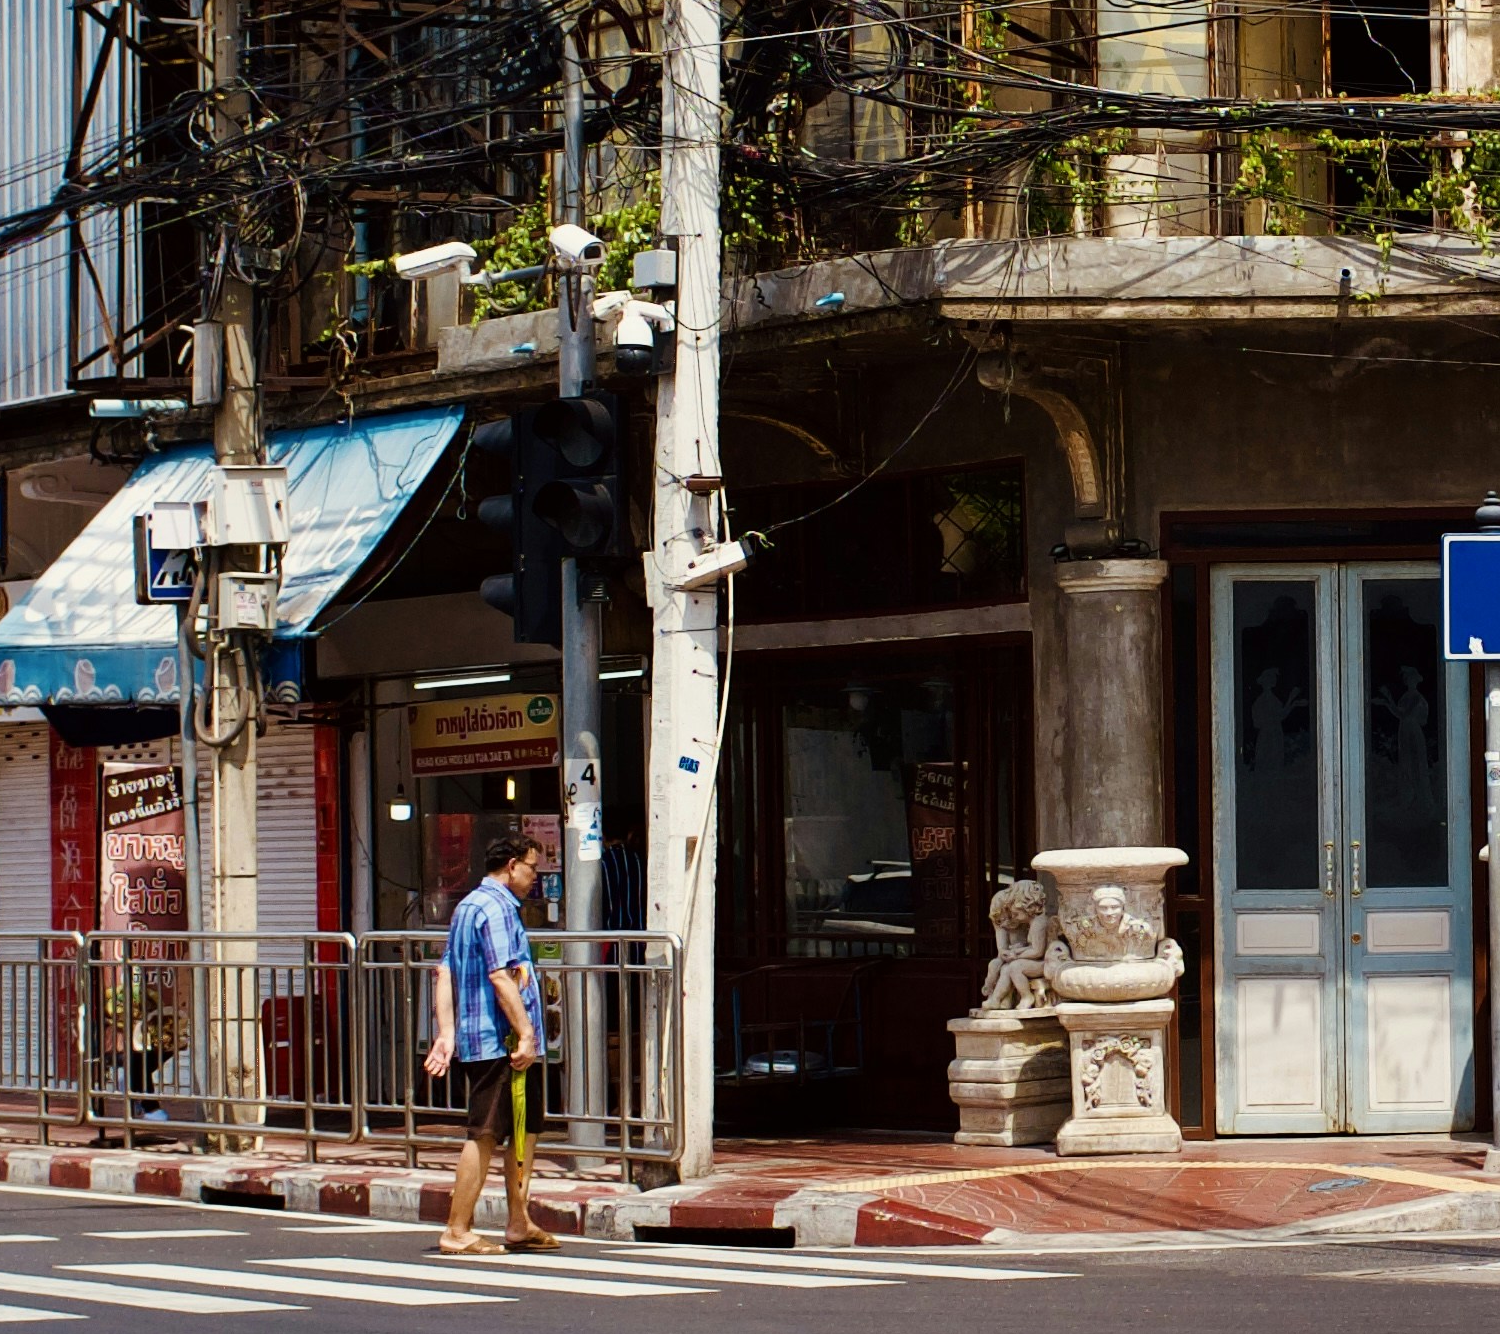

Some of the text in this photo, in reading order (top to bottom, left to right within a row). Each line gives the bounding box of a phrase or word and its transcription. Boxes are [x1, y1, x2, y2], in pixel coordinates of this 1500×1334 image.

[581, 762, 596, 786] 4
[108, 791, 182, 826] ตรงนี้แล้วจ้
[106, 833, 186, 871] ขาหมู
[111, 867, 182, 915] ใส่ถั่ว
